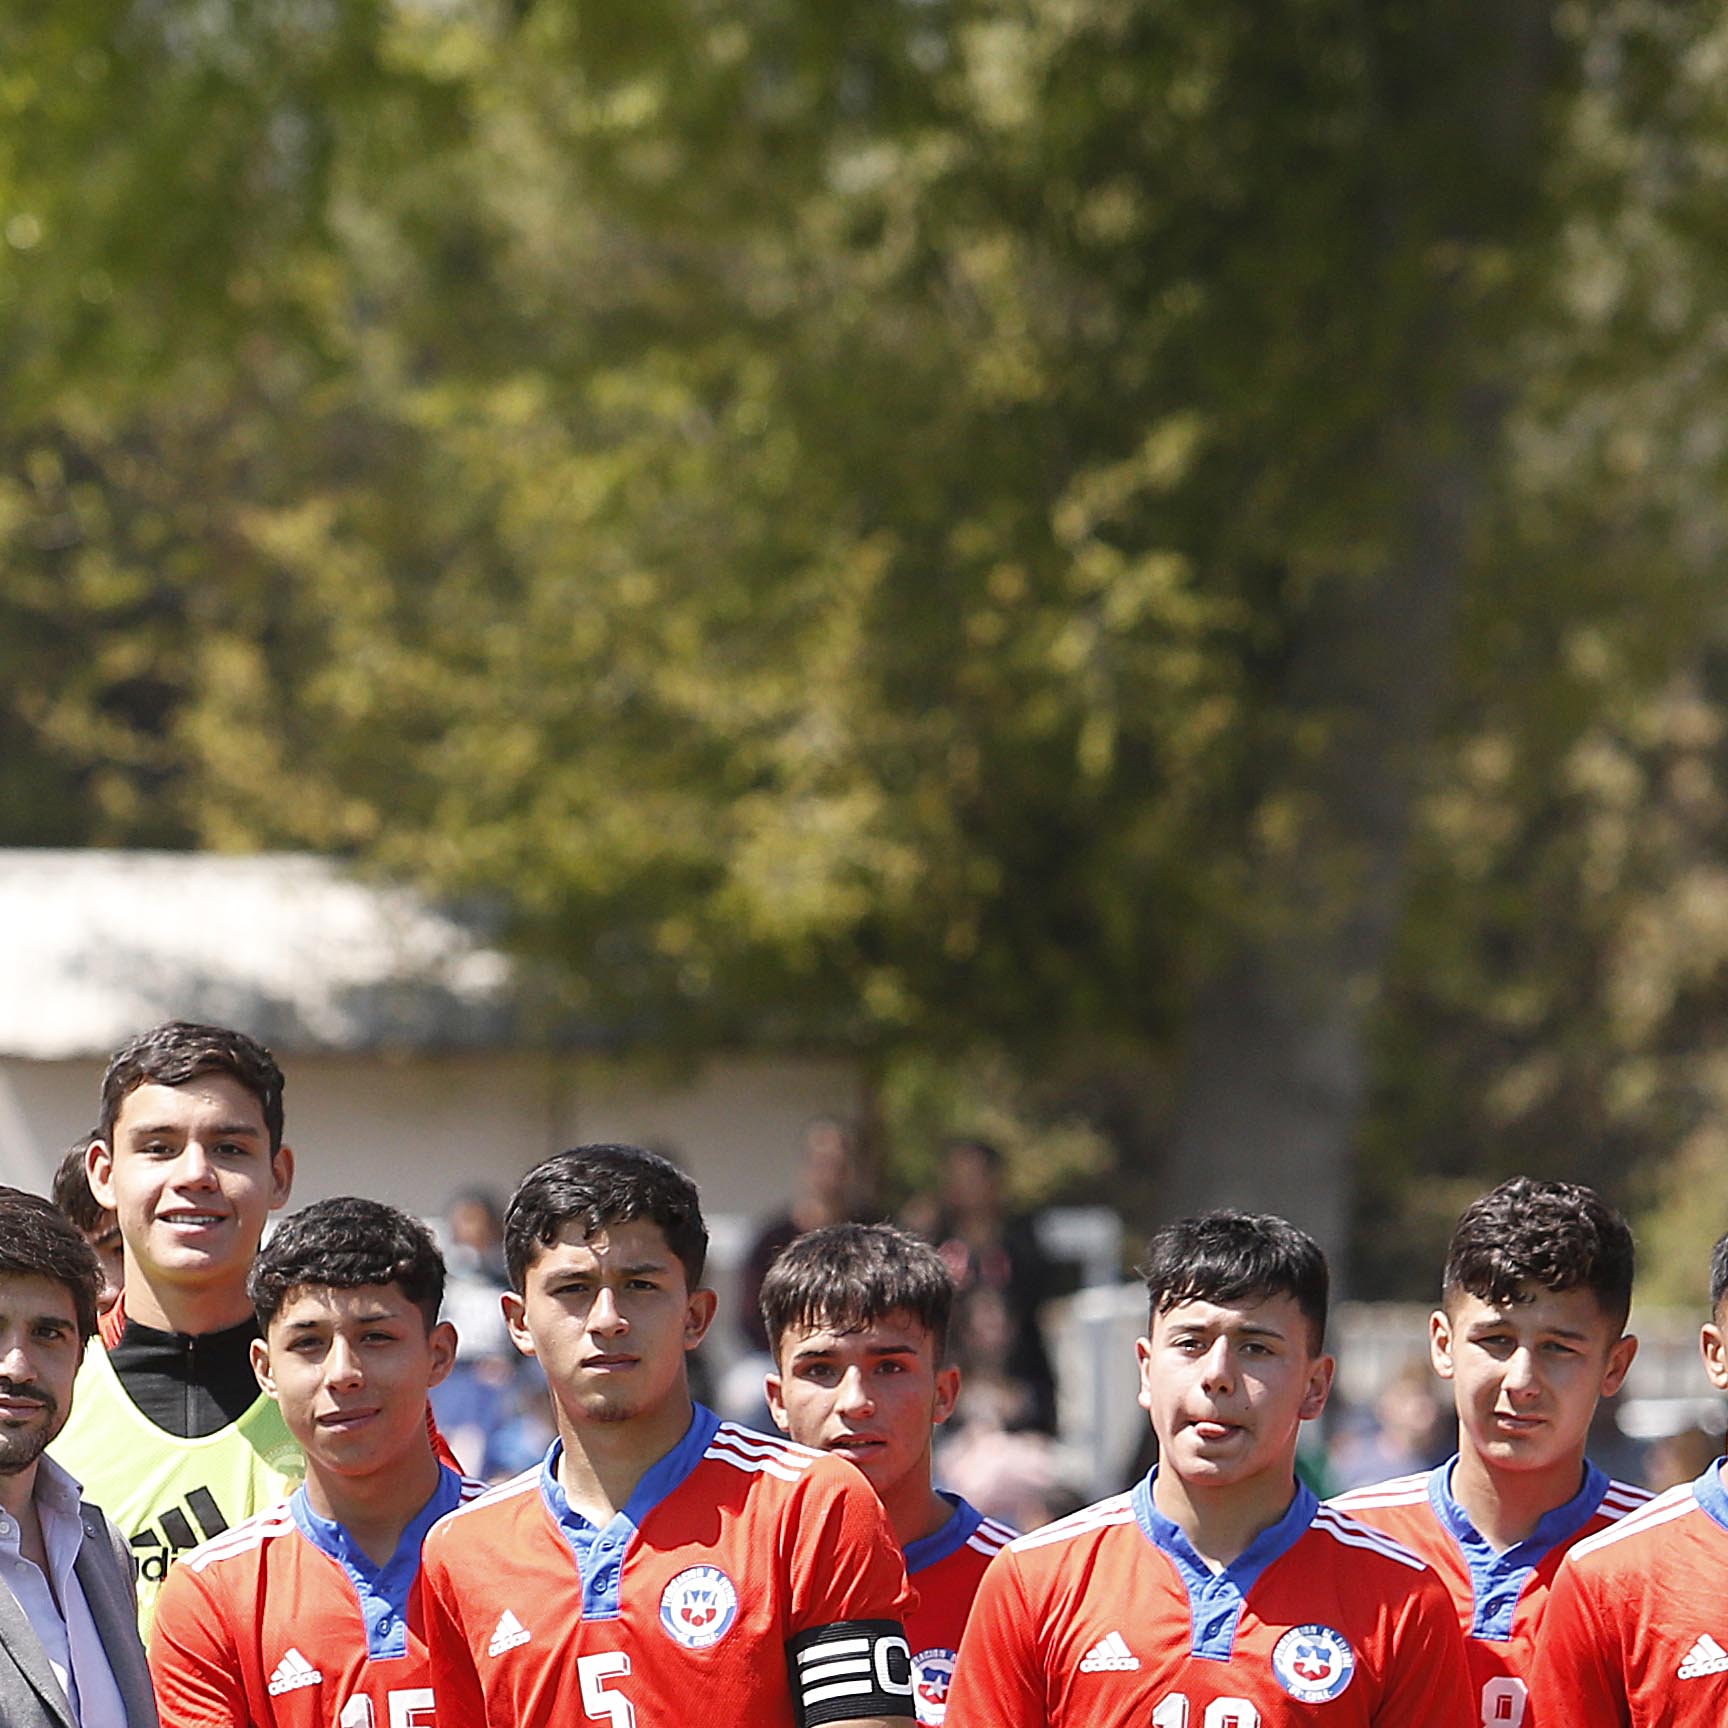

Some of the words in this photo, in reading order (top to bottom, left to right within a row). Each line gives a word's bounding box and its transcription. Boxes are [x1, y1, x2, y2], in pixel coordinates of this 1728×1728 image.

[487, 1630, 531, 1658] adidas
[875, 1636, 913, 1696] C
[1079, 1656, 1141, 1674] adidas
[267, 1669, 323, 1697] adidas
